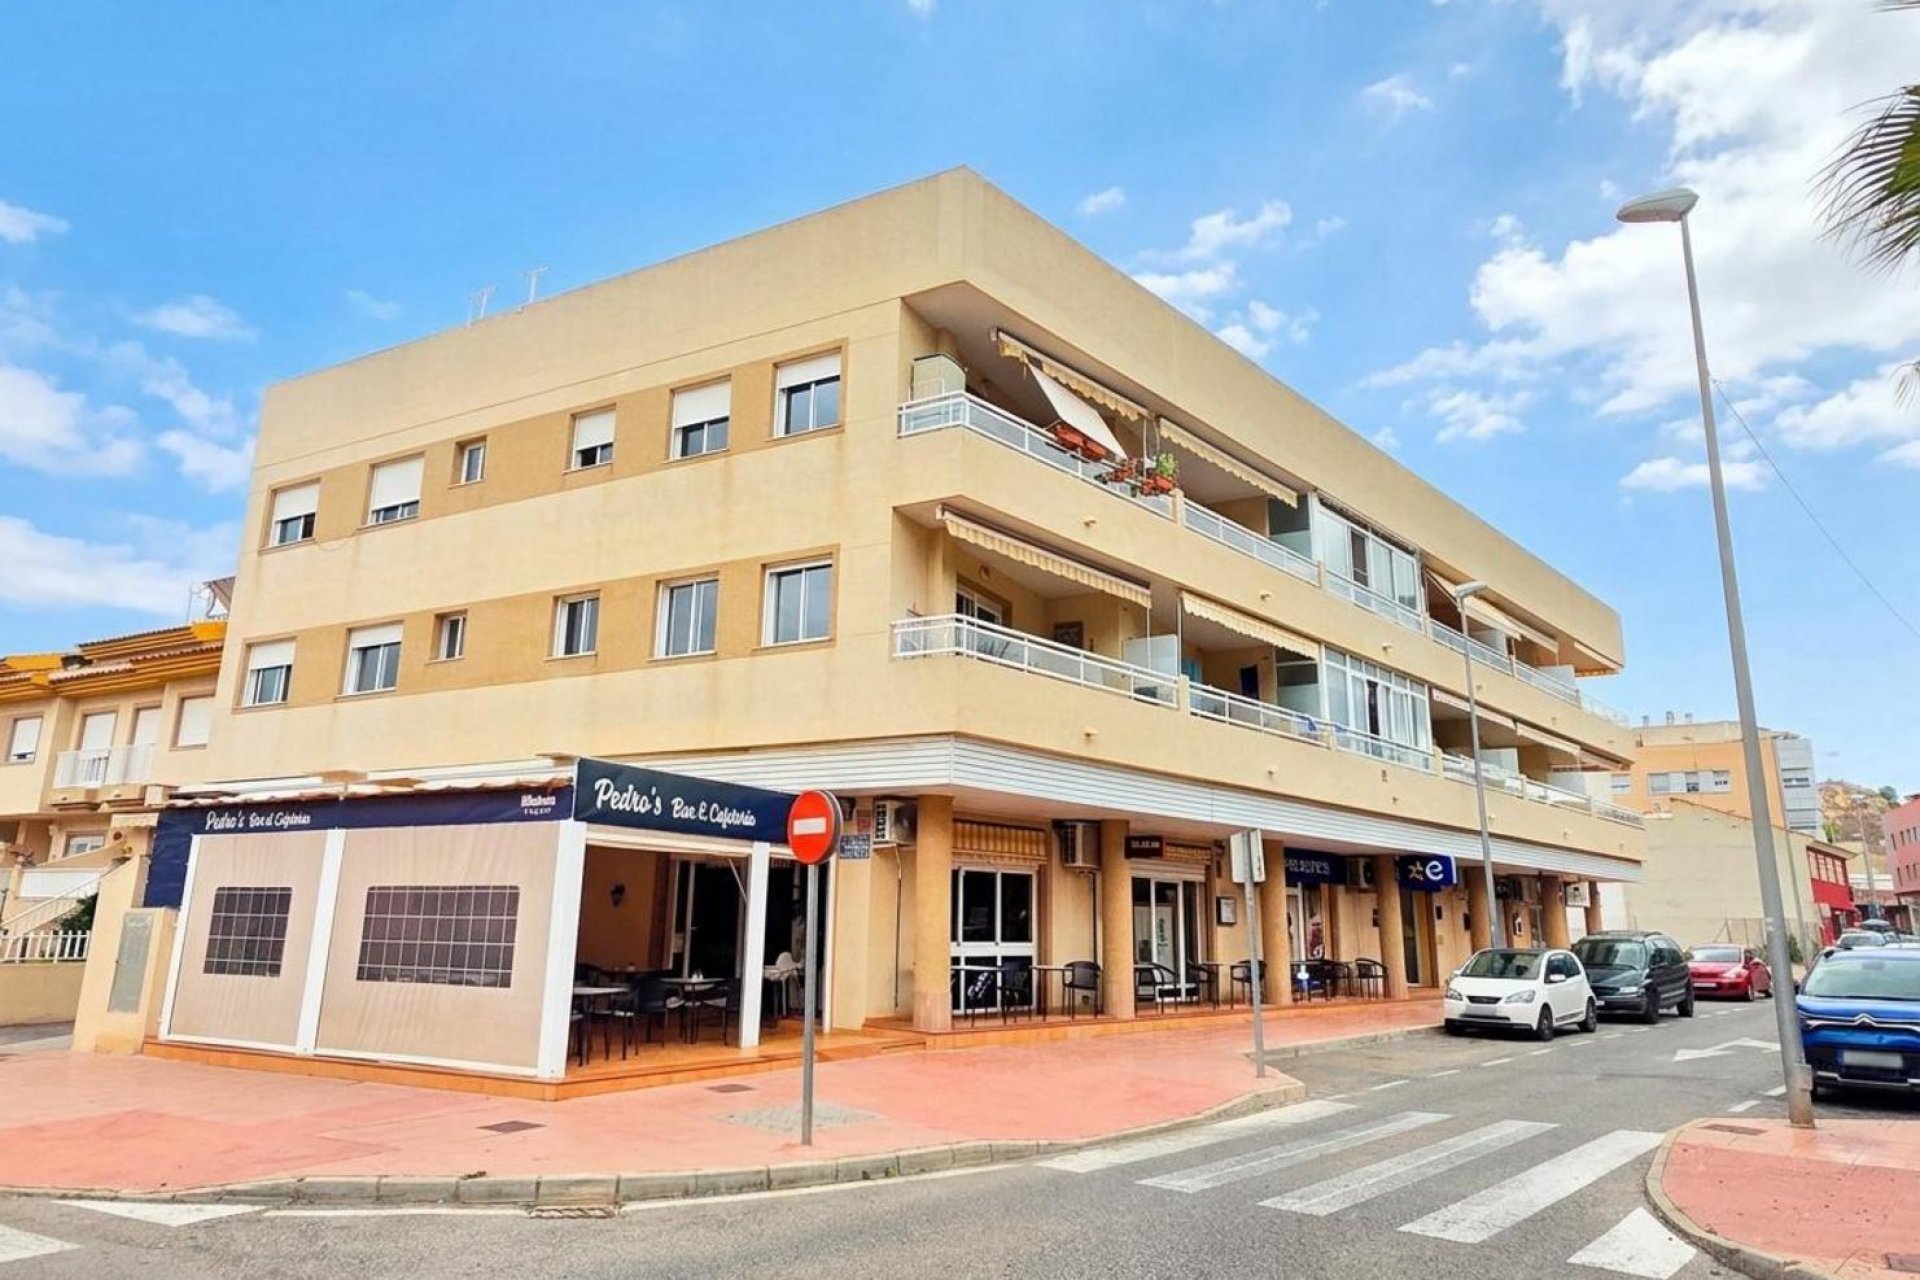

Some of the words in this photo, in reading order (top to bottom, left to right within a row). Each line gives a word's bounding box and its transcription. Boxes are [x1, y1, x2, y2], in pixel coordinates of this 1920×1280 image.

[594, 777, 662, 816] Pedro's
[671, 796, 697, 820] Bar
[205, 810, 245, 831] Pedro's
